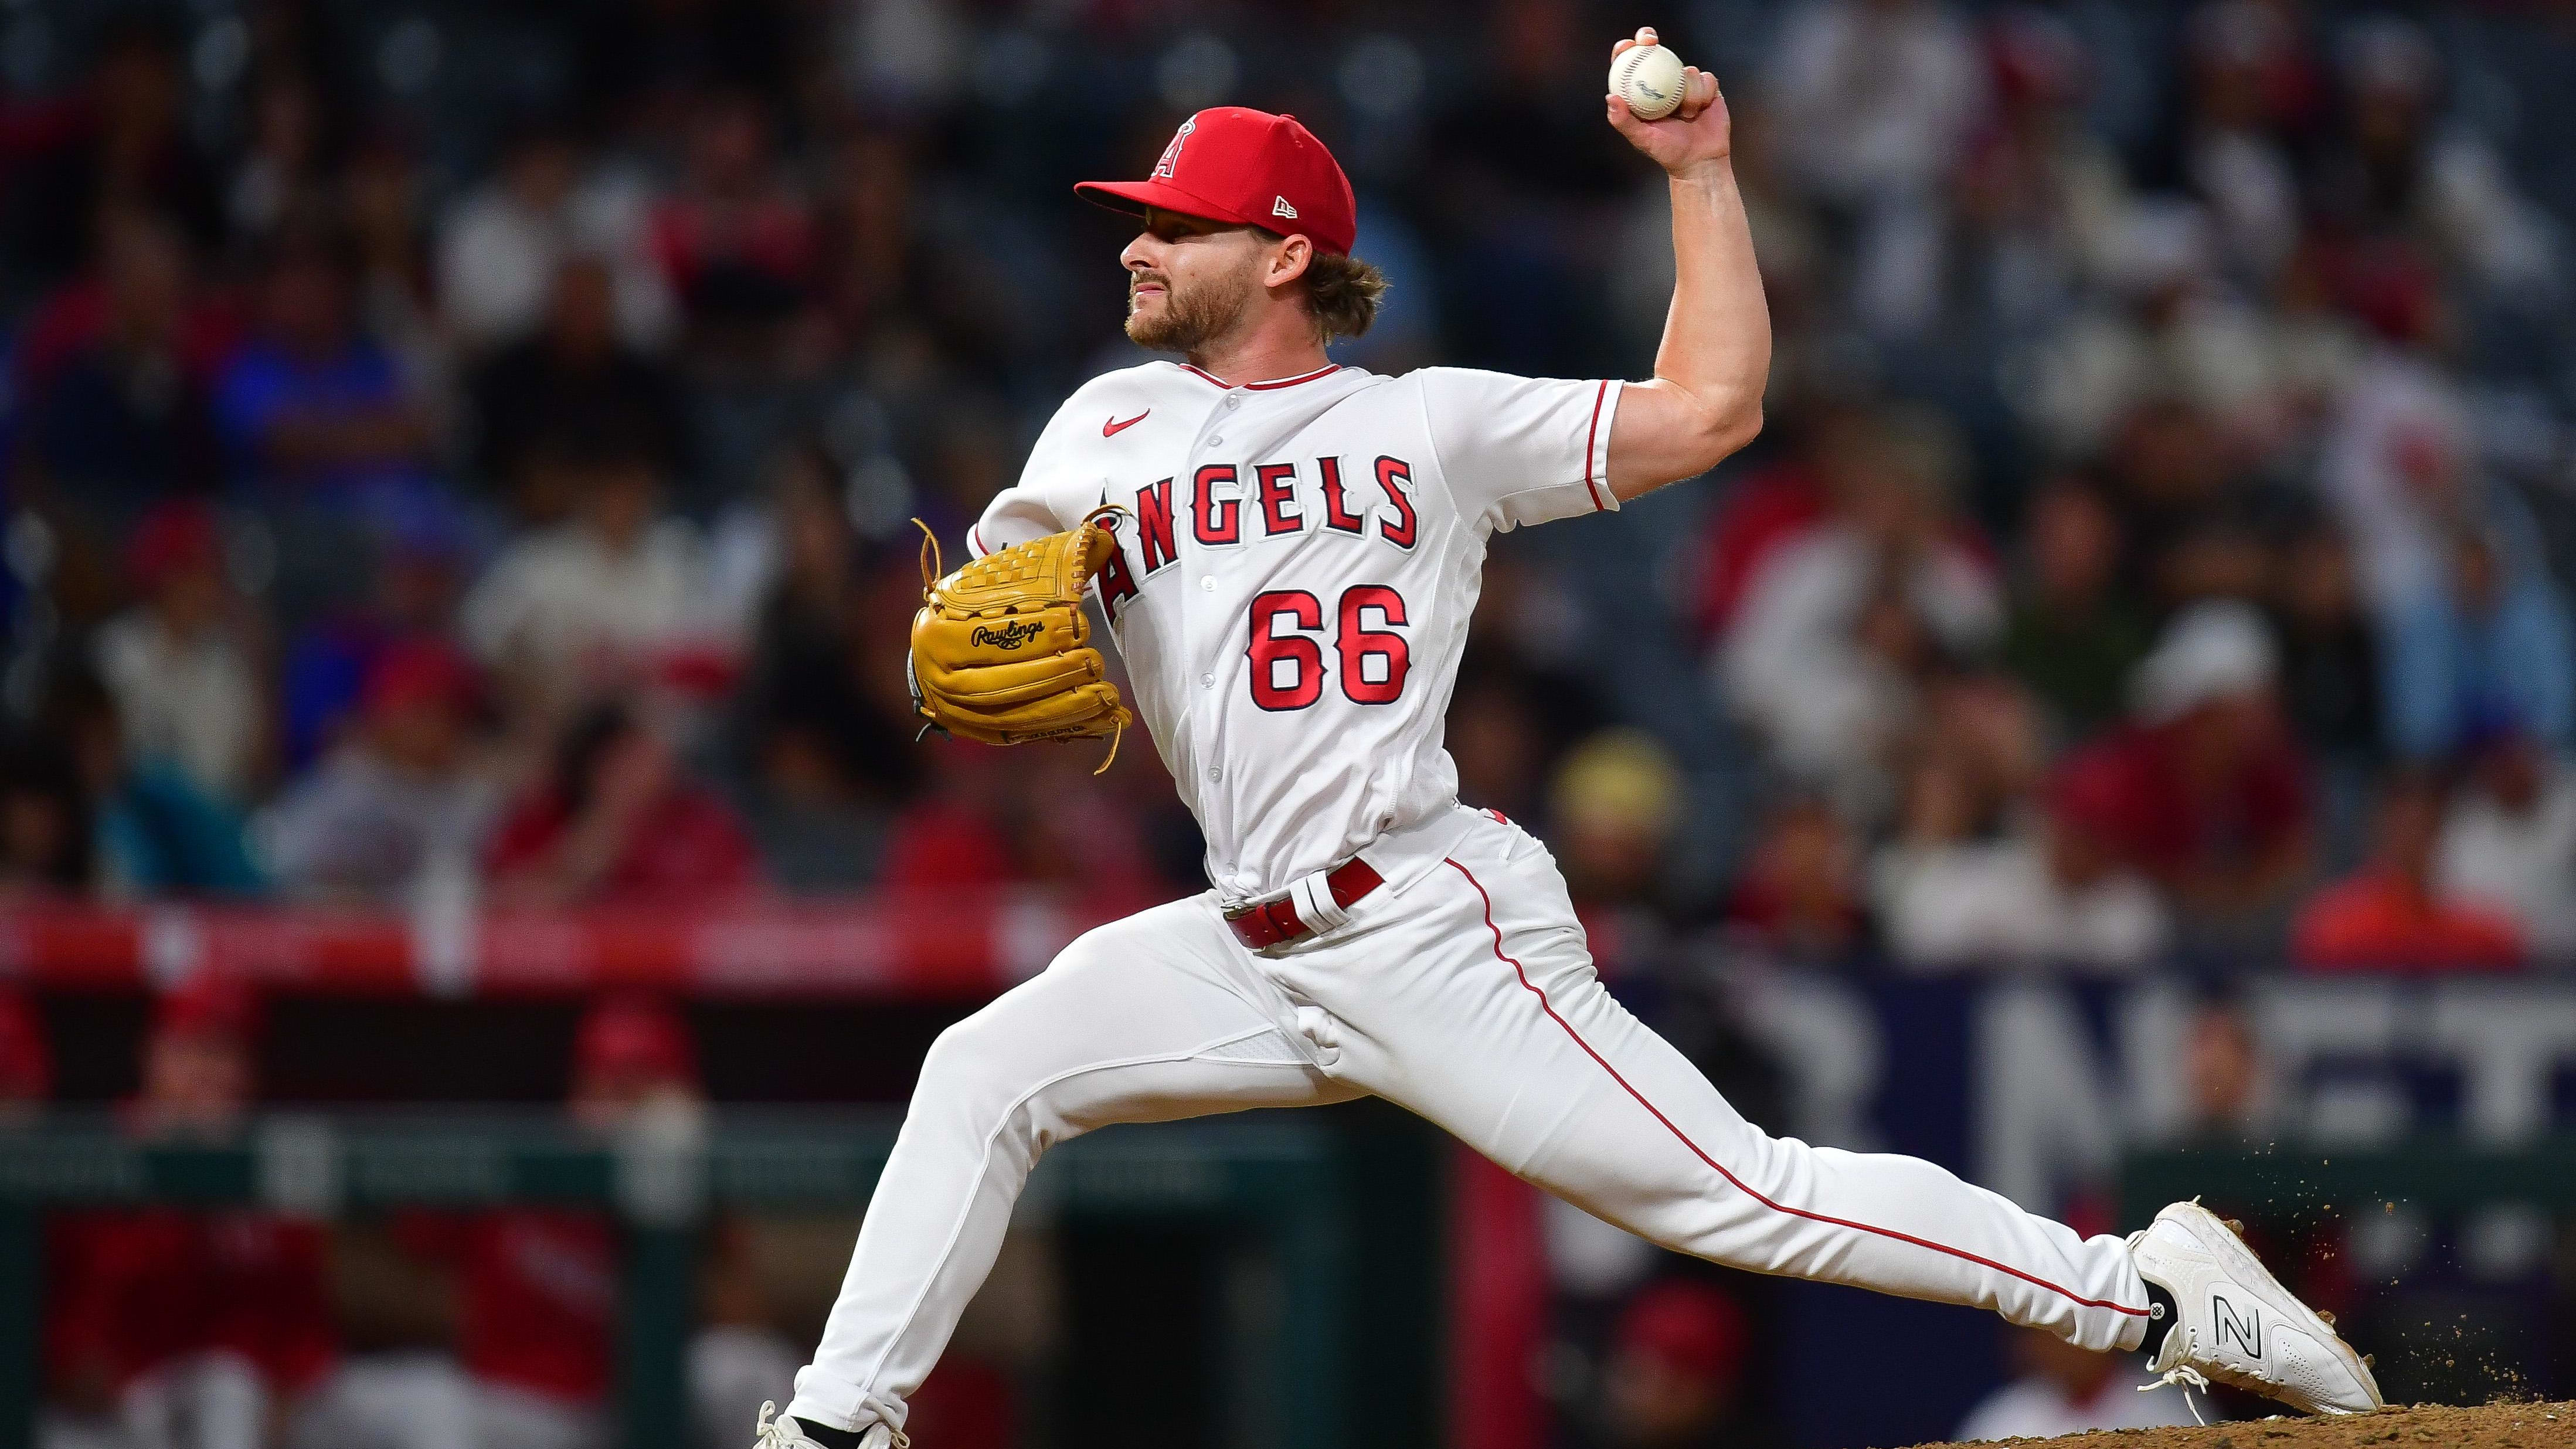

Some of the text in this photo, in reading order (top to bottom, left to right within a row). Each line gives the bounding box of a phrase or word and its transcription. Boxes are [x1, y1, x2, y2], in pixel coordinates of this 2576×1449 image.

[1090, 454, 1418, 629] ANGELS
[971, 620, 1045, 649] Rawlings
[1244, 584, 1412, 712] 66
